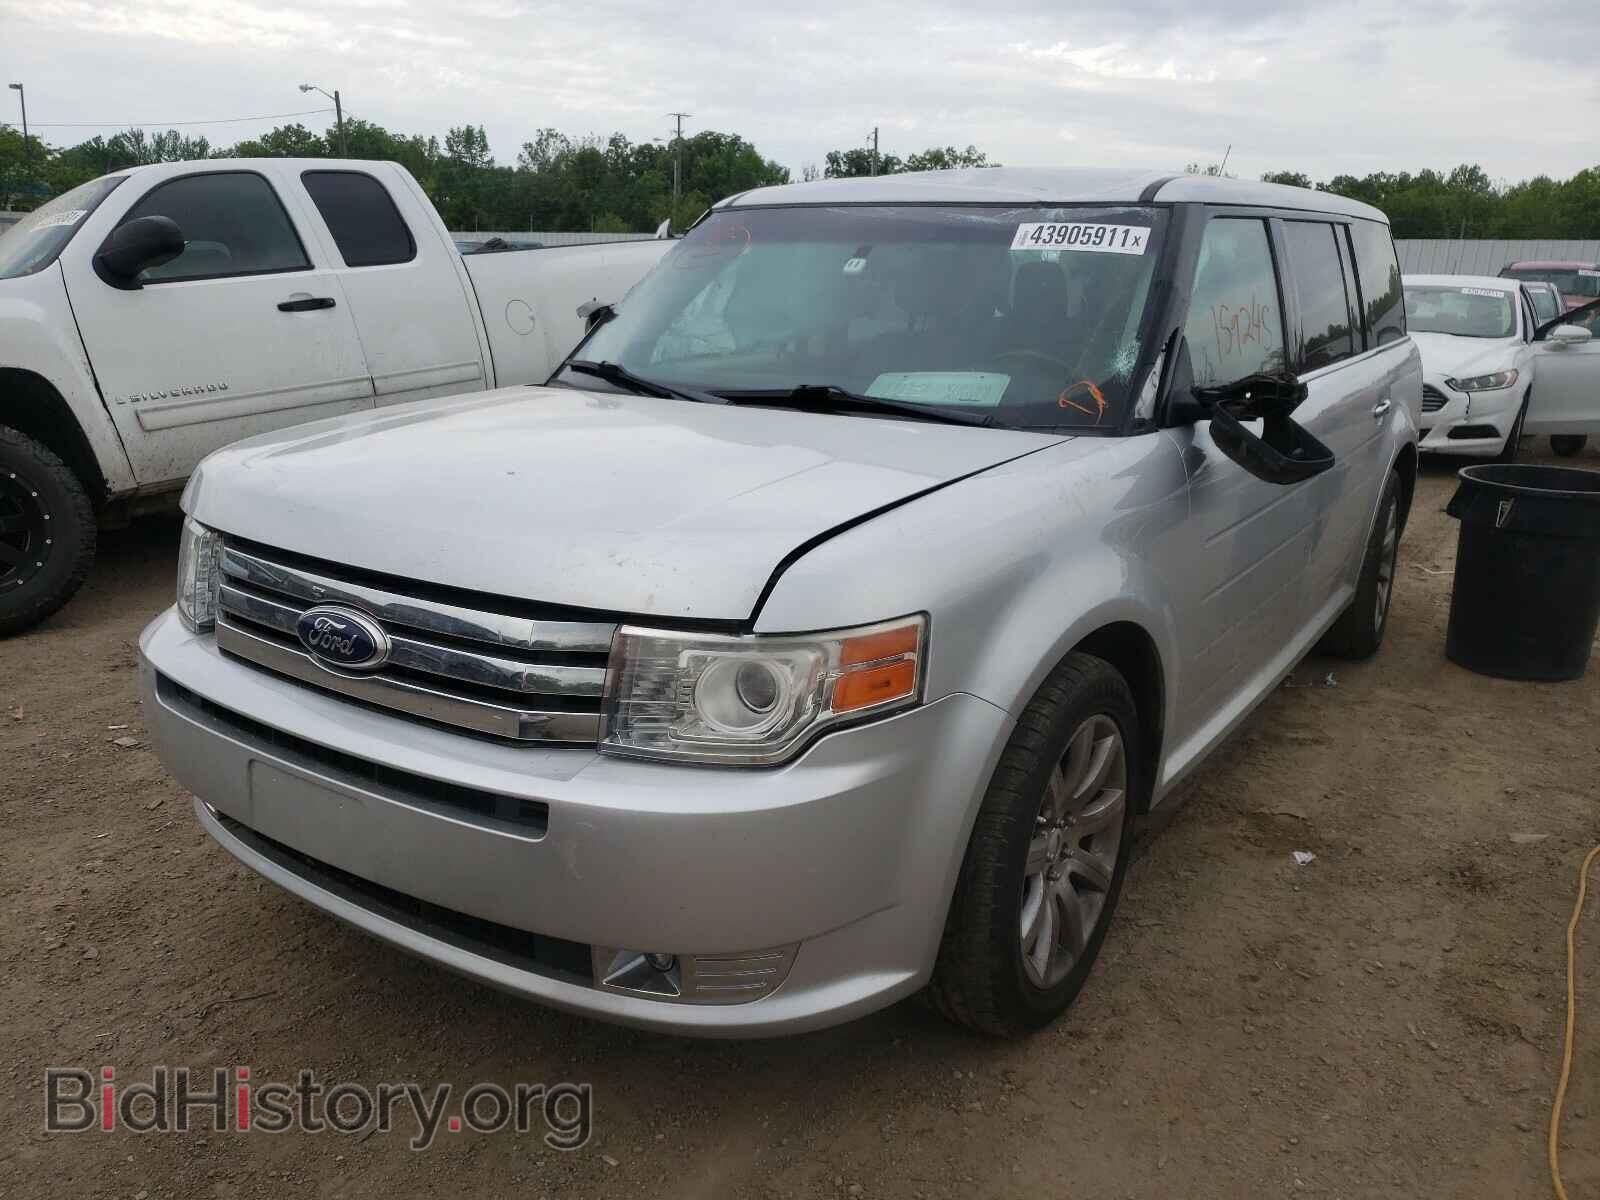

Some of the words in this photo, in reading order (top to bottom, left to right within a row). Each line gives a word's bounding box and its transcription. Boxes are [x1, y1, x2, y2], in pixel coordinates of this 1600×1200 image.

[1030, 225, 1130, 247] 43905911
[129, 382, 228, 402] SILVERADO
[308, 616, 359, 656] Ford
